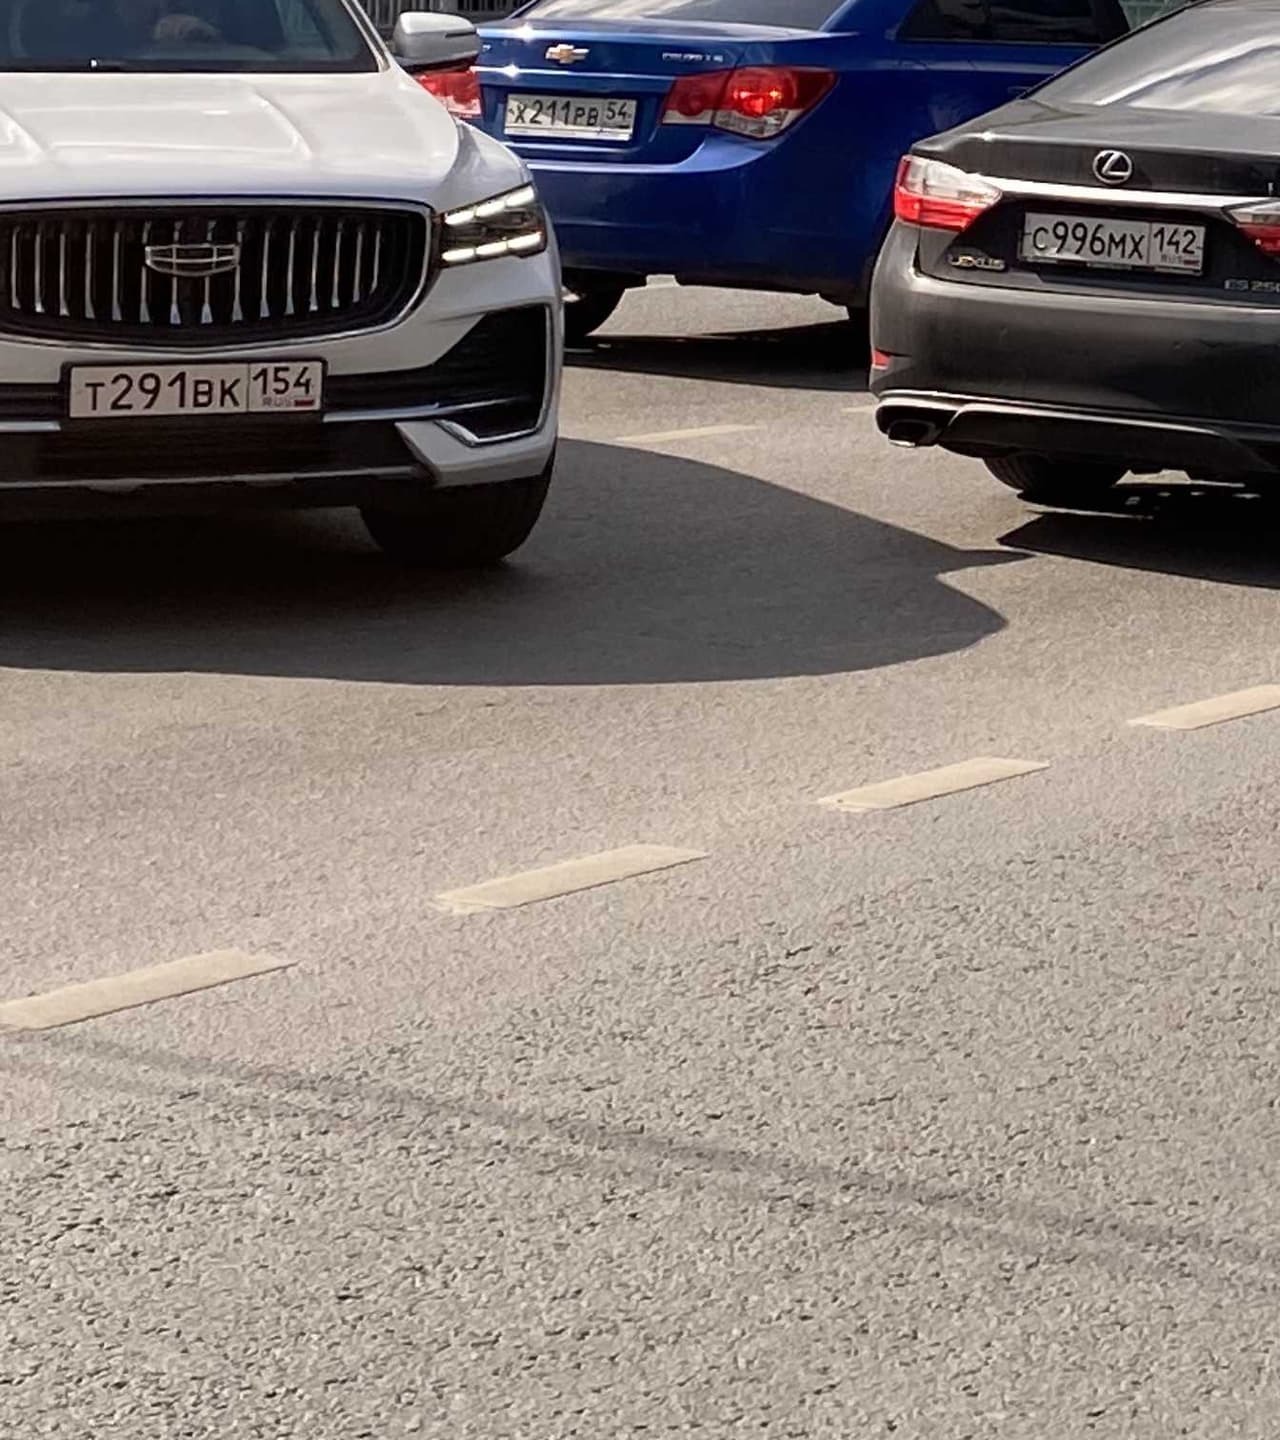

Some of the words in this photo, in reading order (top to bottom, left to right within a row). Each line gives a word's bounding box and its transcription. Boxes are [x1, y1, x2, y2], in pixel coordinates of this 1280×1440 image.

[605, 101, 629, 121] 54
[1032, 220, 1145, 260] С996МХ
[1153, 228, 1197, 255] 142
[85, 370, 242, 411] Т291ВК
[252, 366, 312, 396] 154
